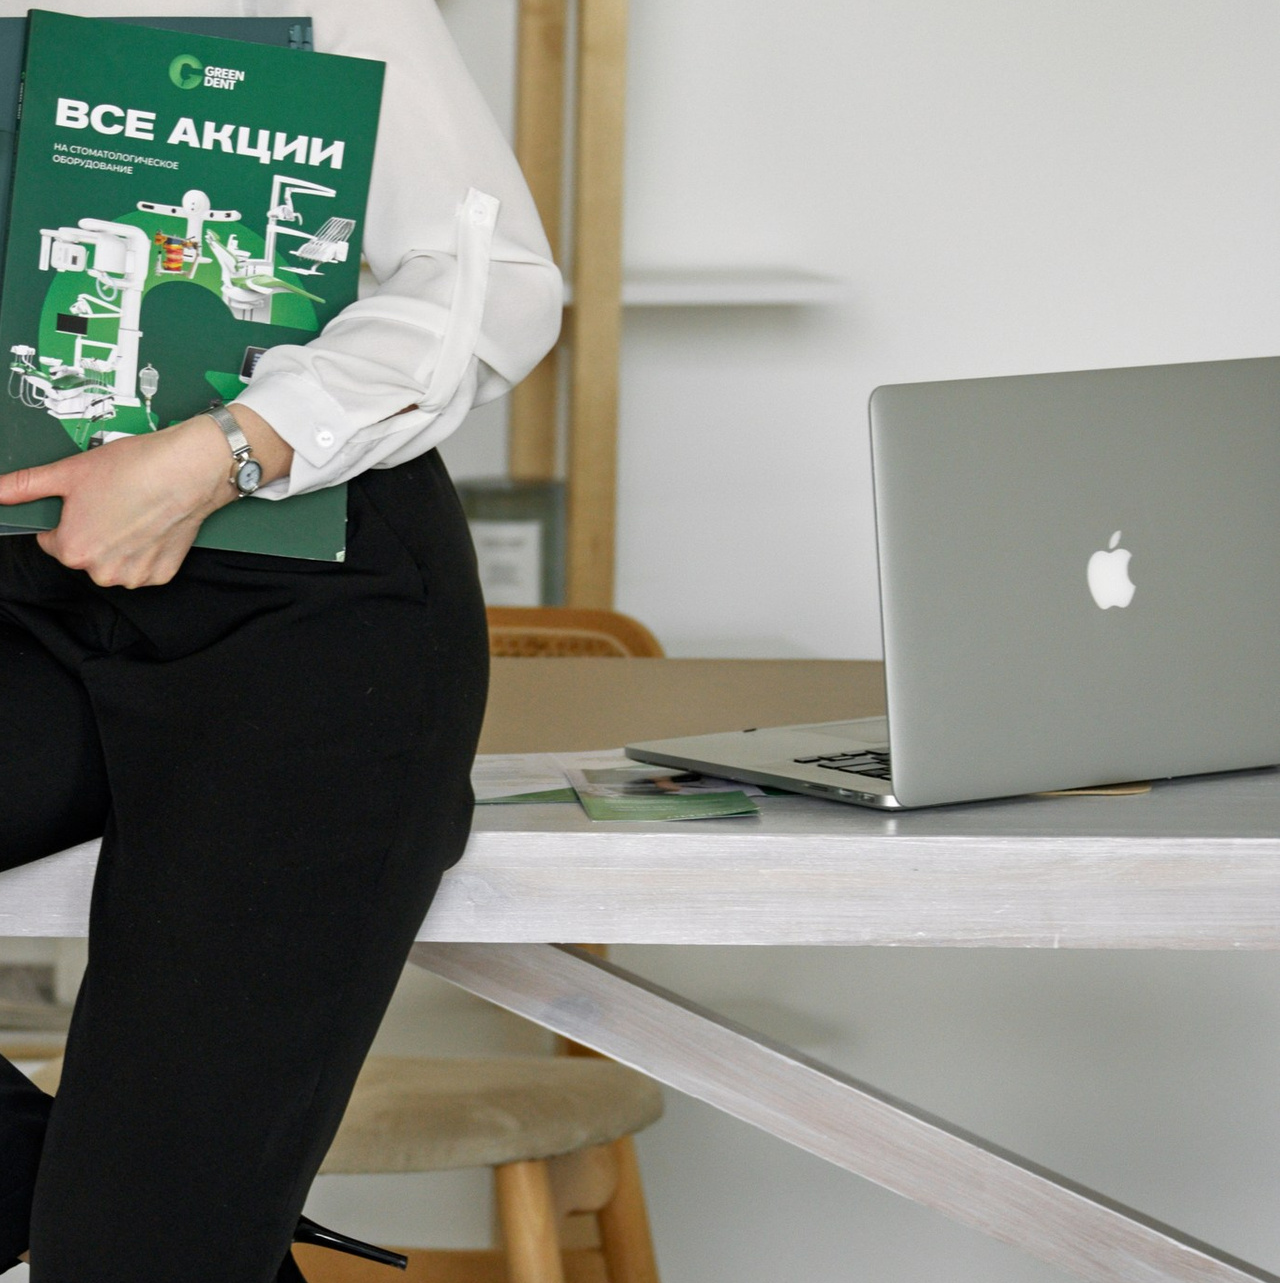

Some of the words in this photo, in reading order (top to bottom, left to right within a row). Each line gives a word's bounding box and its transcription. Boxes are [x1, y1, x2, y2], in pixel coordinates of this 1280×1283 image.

[203, 76, 237, 90] DENT
[204, 66, 245, 81] GREEN
[55, 97, 157, 141] ВСЕ
[166, 117, 345, 170] АКЦИИ
[52, 154, 133, 175] ОБОРУДОВАНИЕ
[53, 142, 68, 152] НА
[69, 145, 179, 170] СТОМАТОЛОГИЧЕСКОЕ
